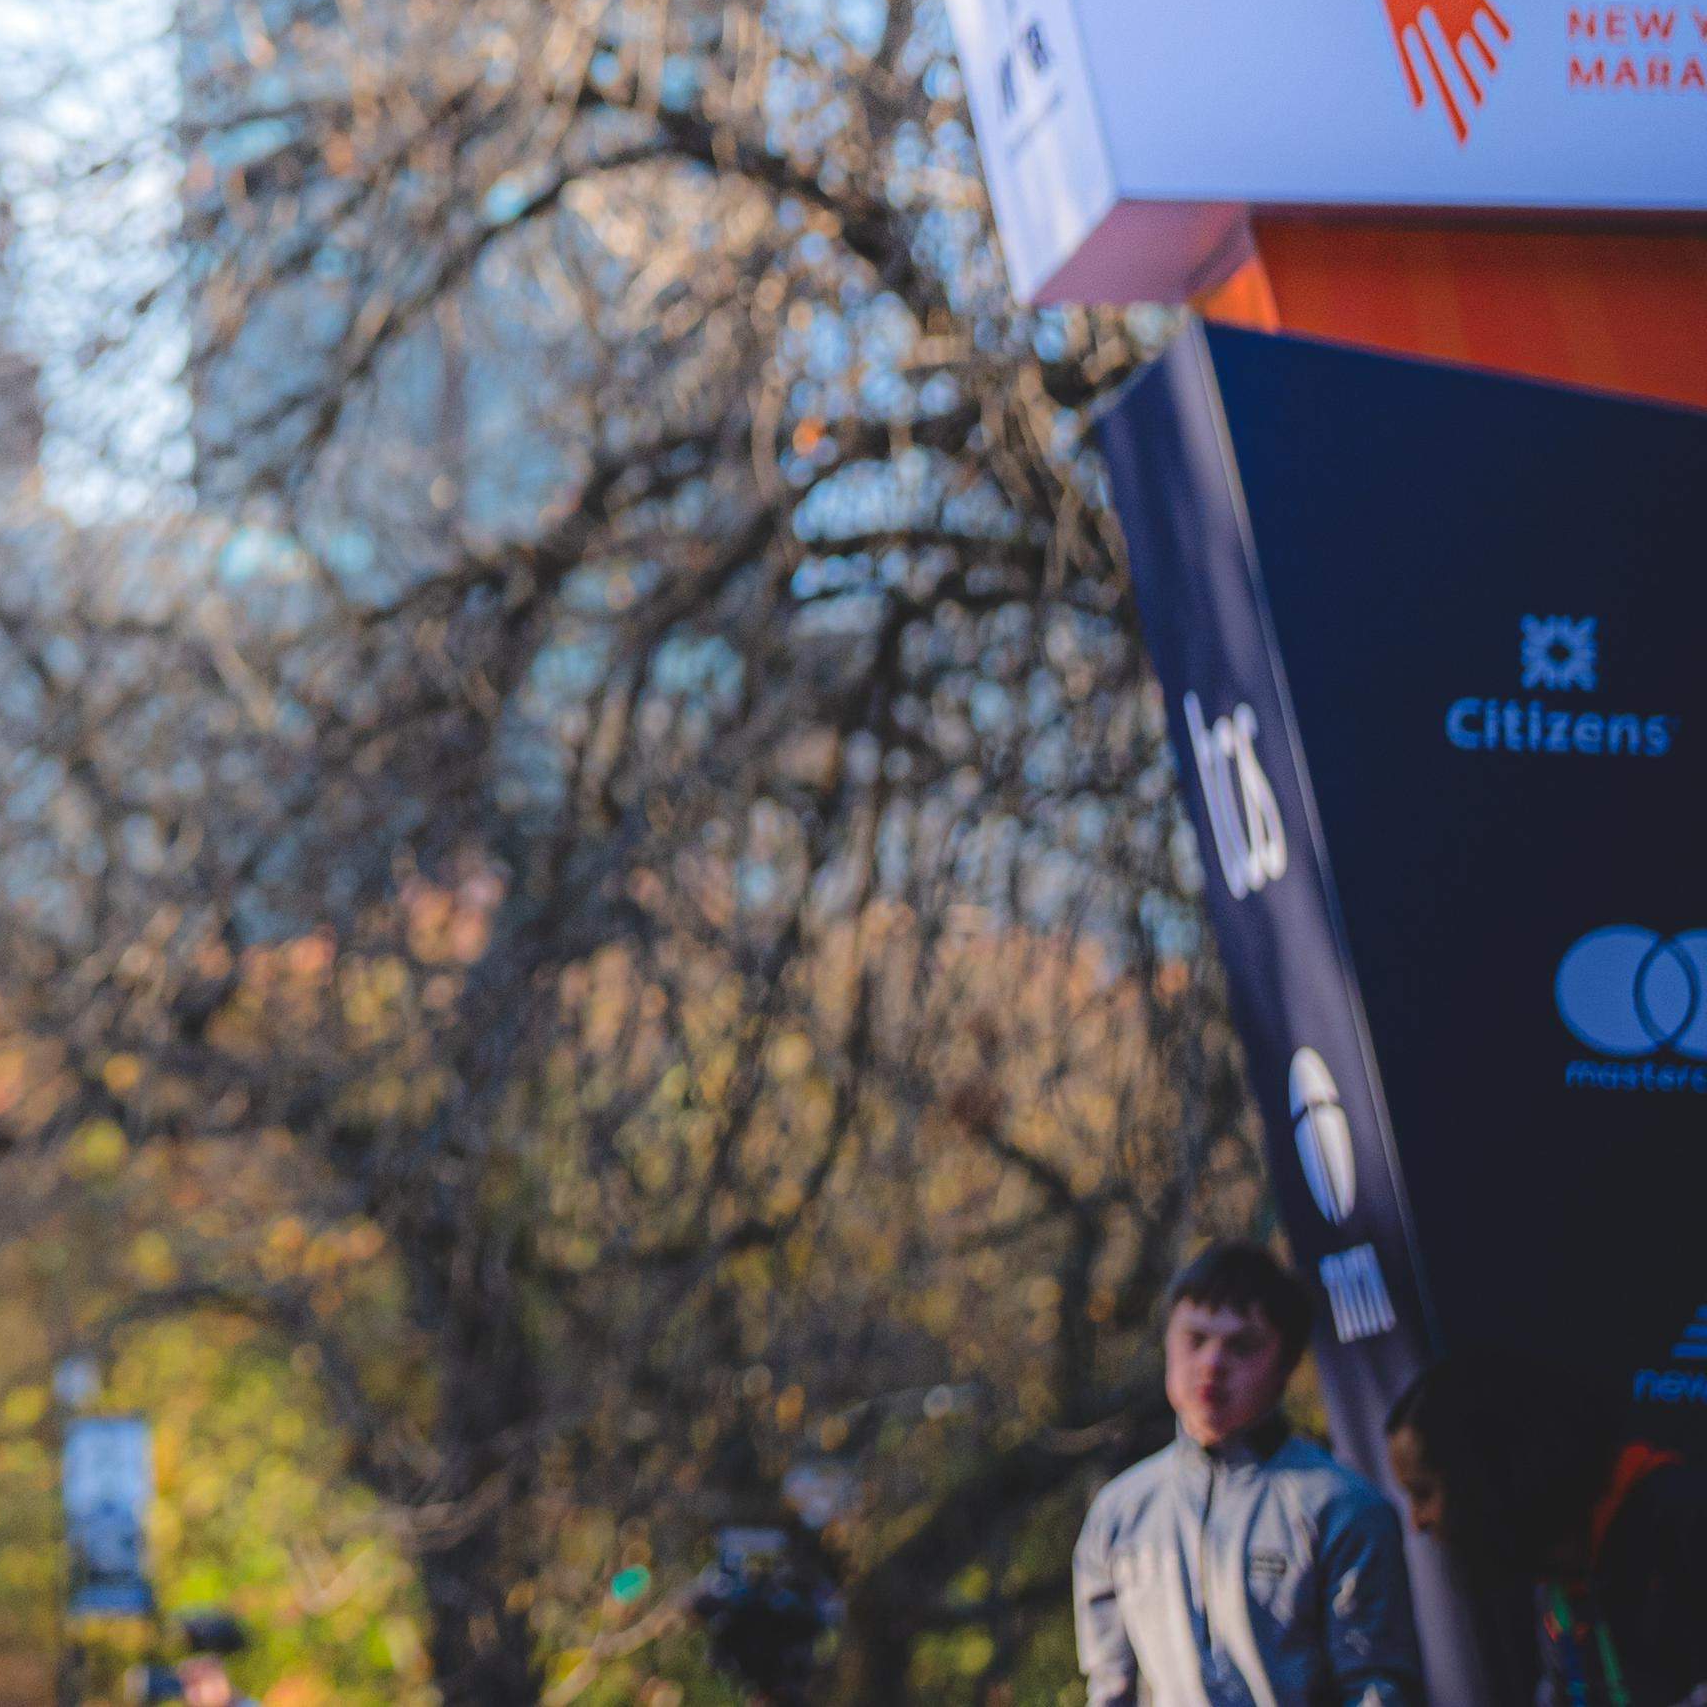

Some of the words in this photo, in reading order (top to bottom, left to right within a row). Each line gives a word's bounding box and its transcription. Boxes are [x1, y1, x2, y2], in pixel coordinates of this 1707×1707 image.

[1567, 6, 1677, 43] NEW
[1567, 54, 1707, 91] MARA
[1444, 696, 1671, 757] Citizens
